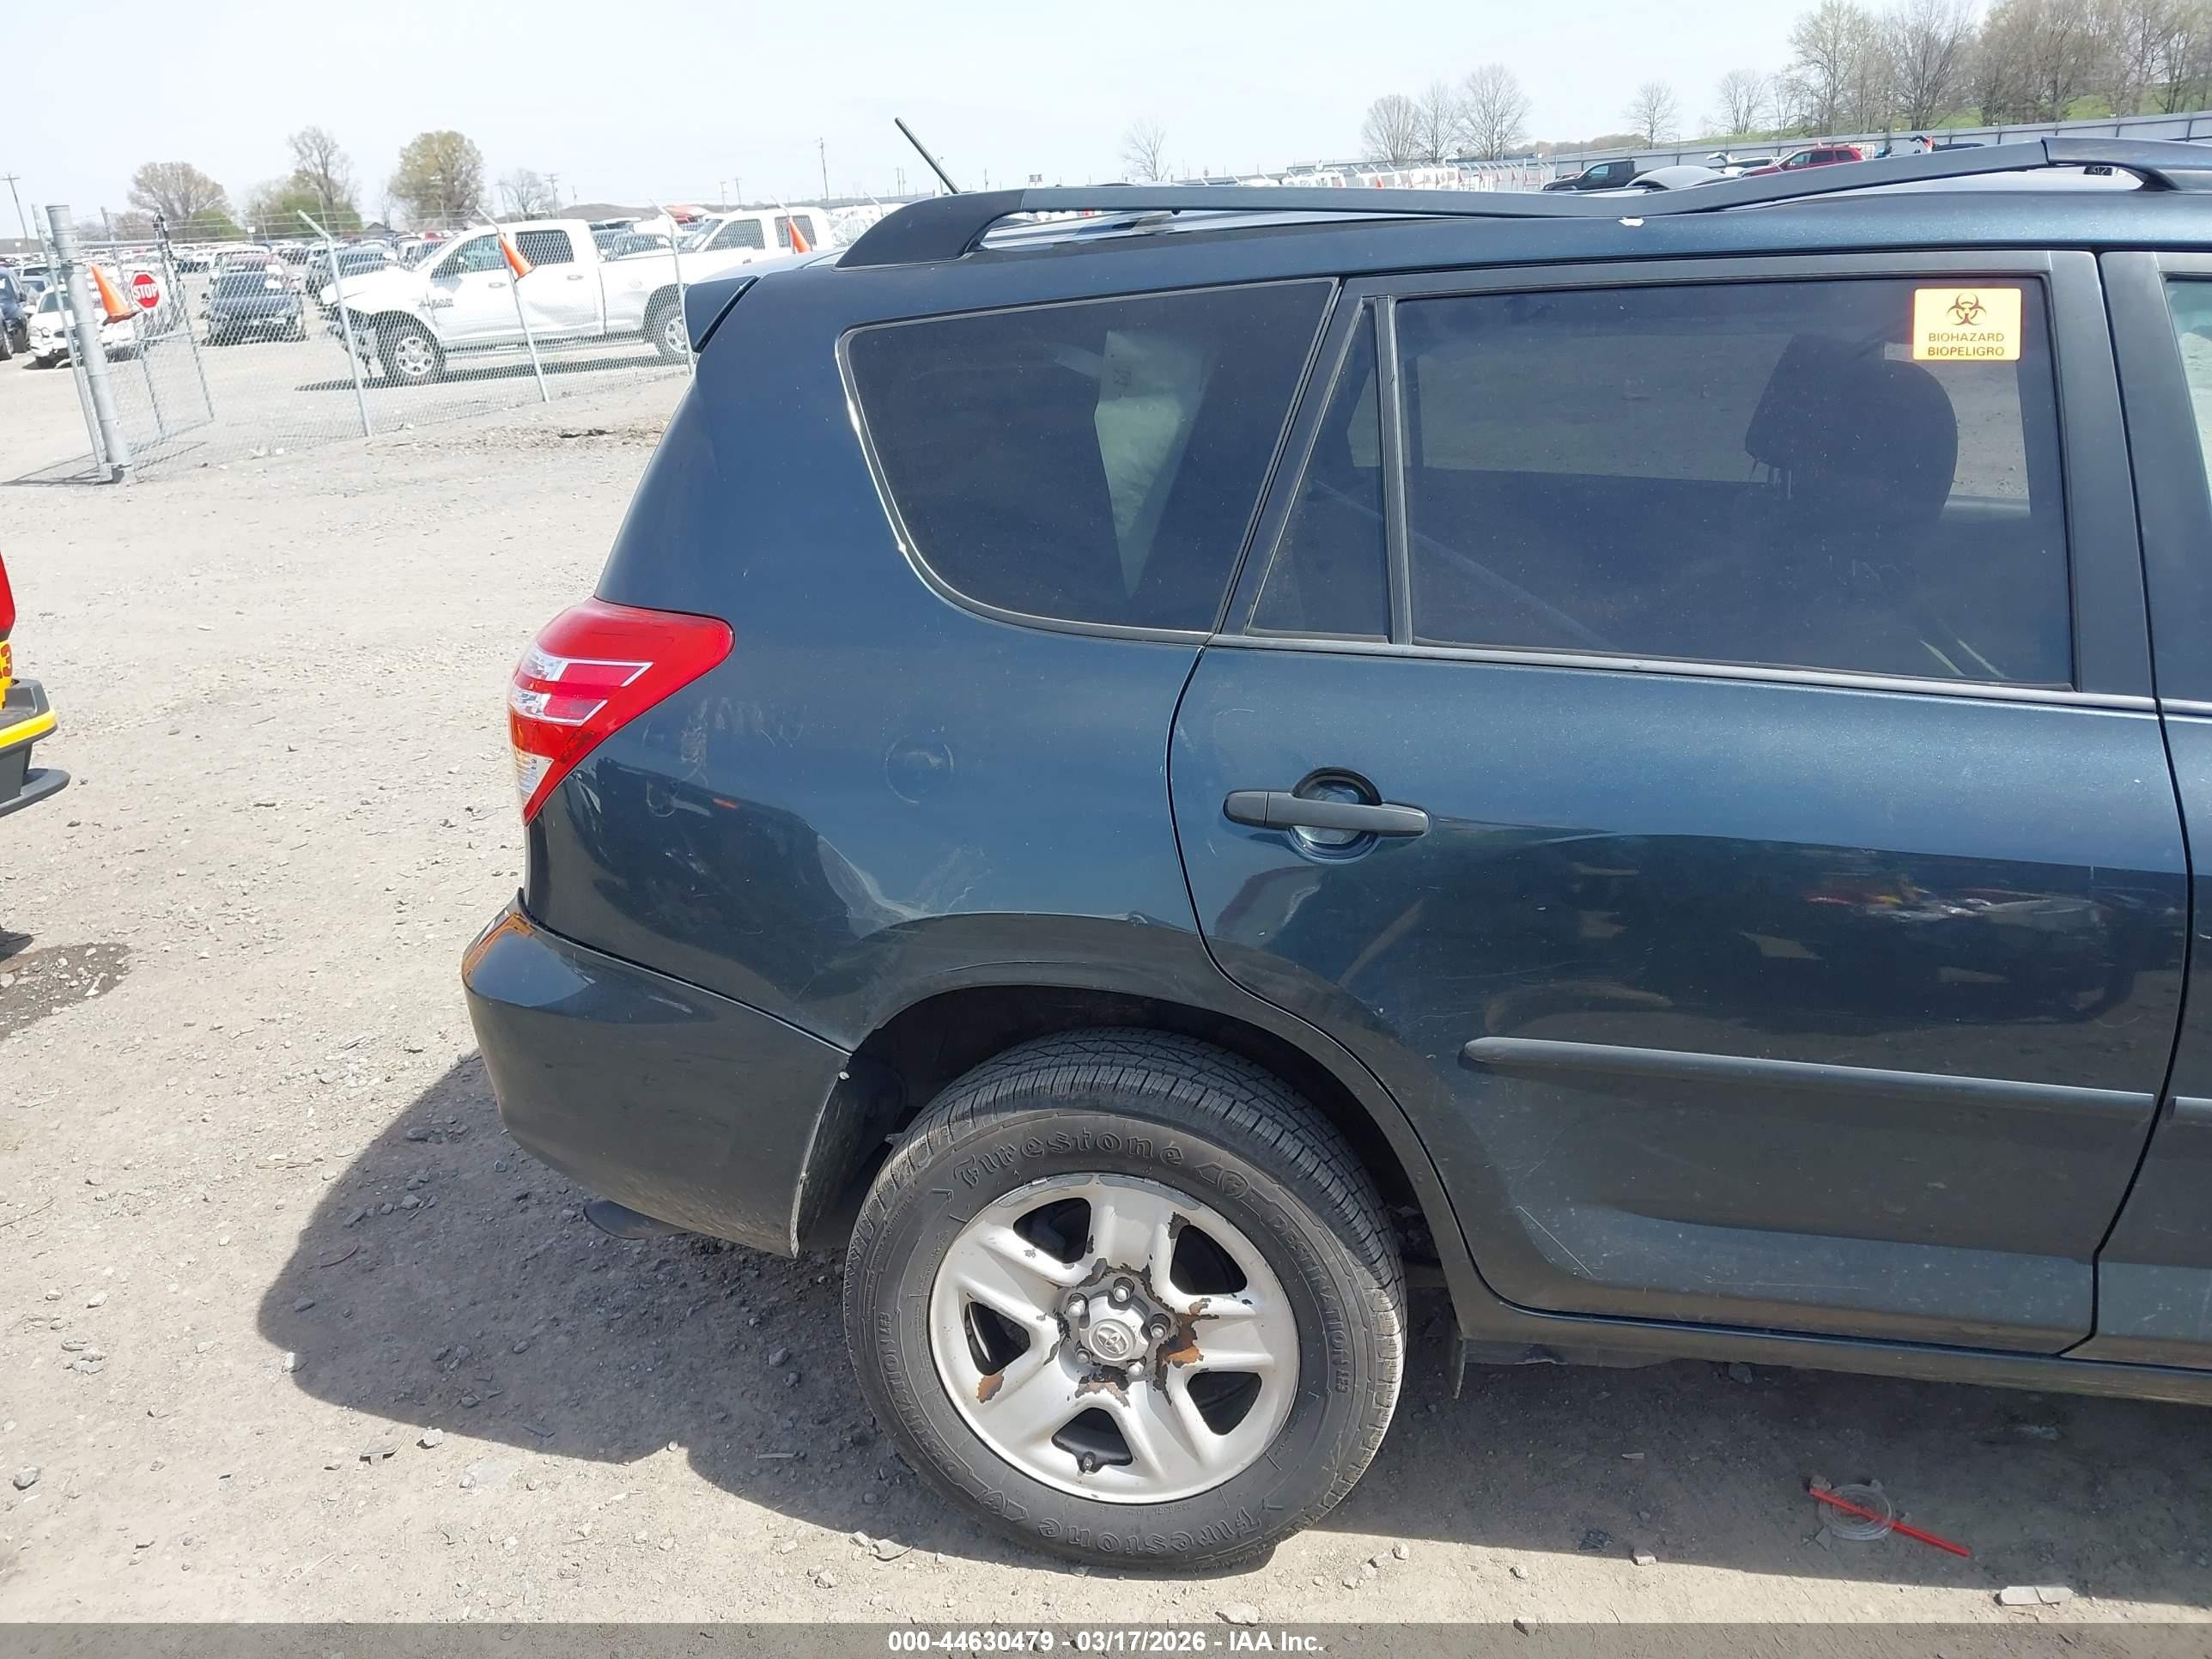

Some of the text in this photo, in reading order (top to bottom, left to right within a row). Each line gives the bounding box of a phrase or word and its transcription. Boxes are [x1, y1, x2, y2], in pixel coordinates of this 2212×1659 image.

[133, 283, 158, 301] STOP
[1928, 332, 2005, 342] BIOHAZARD
[1927, 346, 2005, 356] BIOPELIGRO
[953, 1126, 1185, 1189] Firestone
[1037, 1506, 1261, 1553] Firestone
